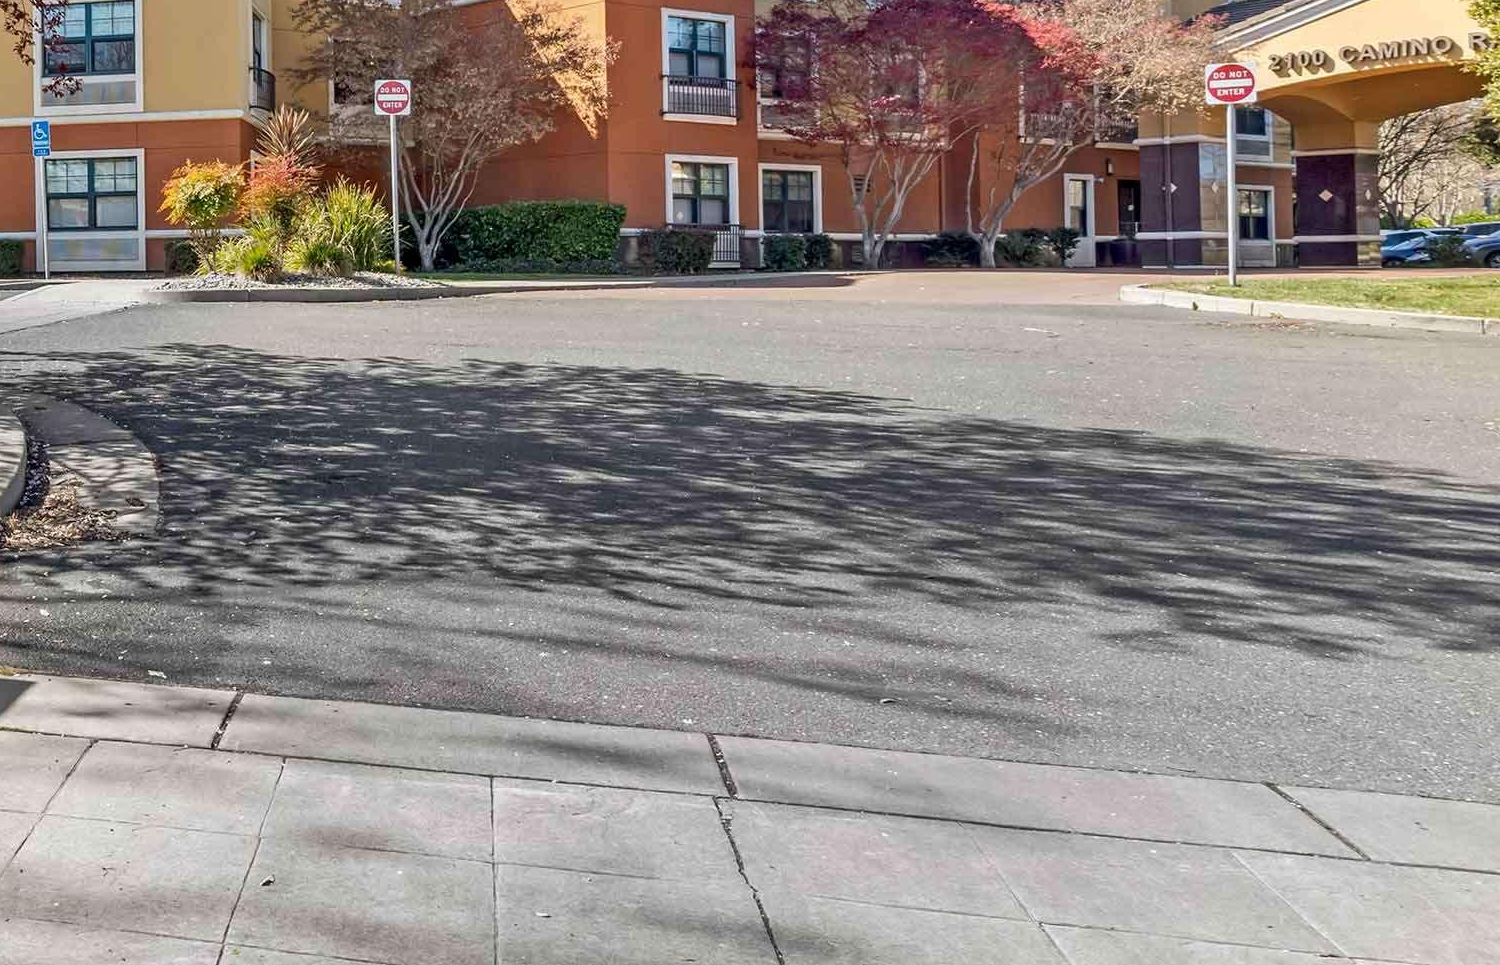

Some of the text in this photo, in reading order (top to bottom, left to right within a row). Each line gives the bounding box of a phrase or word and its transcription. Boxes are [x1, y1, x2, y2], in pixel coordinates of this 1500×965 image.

[1339, 36, 1452, 62] CAMINO
[1213, 70, 1248, 79] DO NOT
[1217, 88, 1244, 96] ENTER
